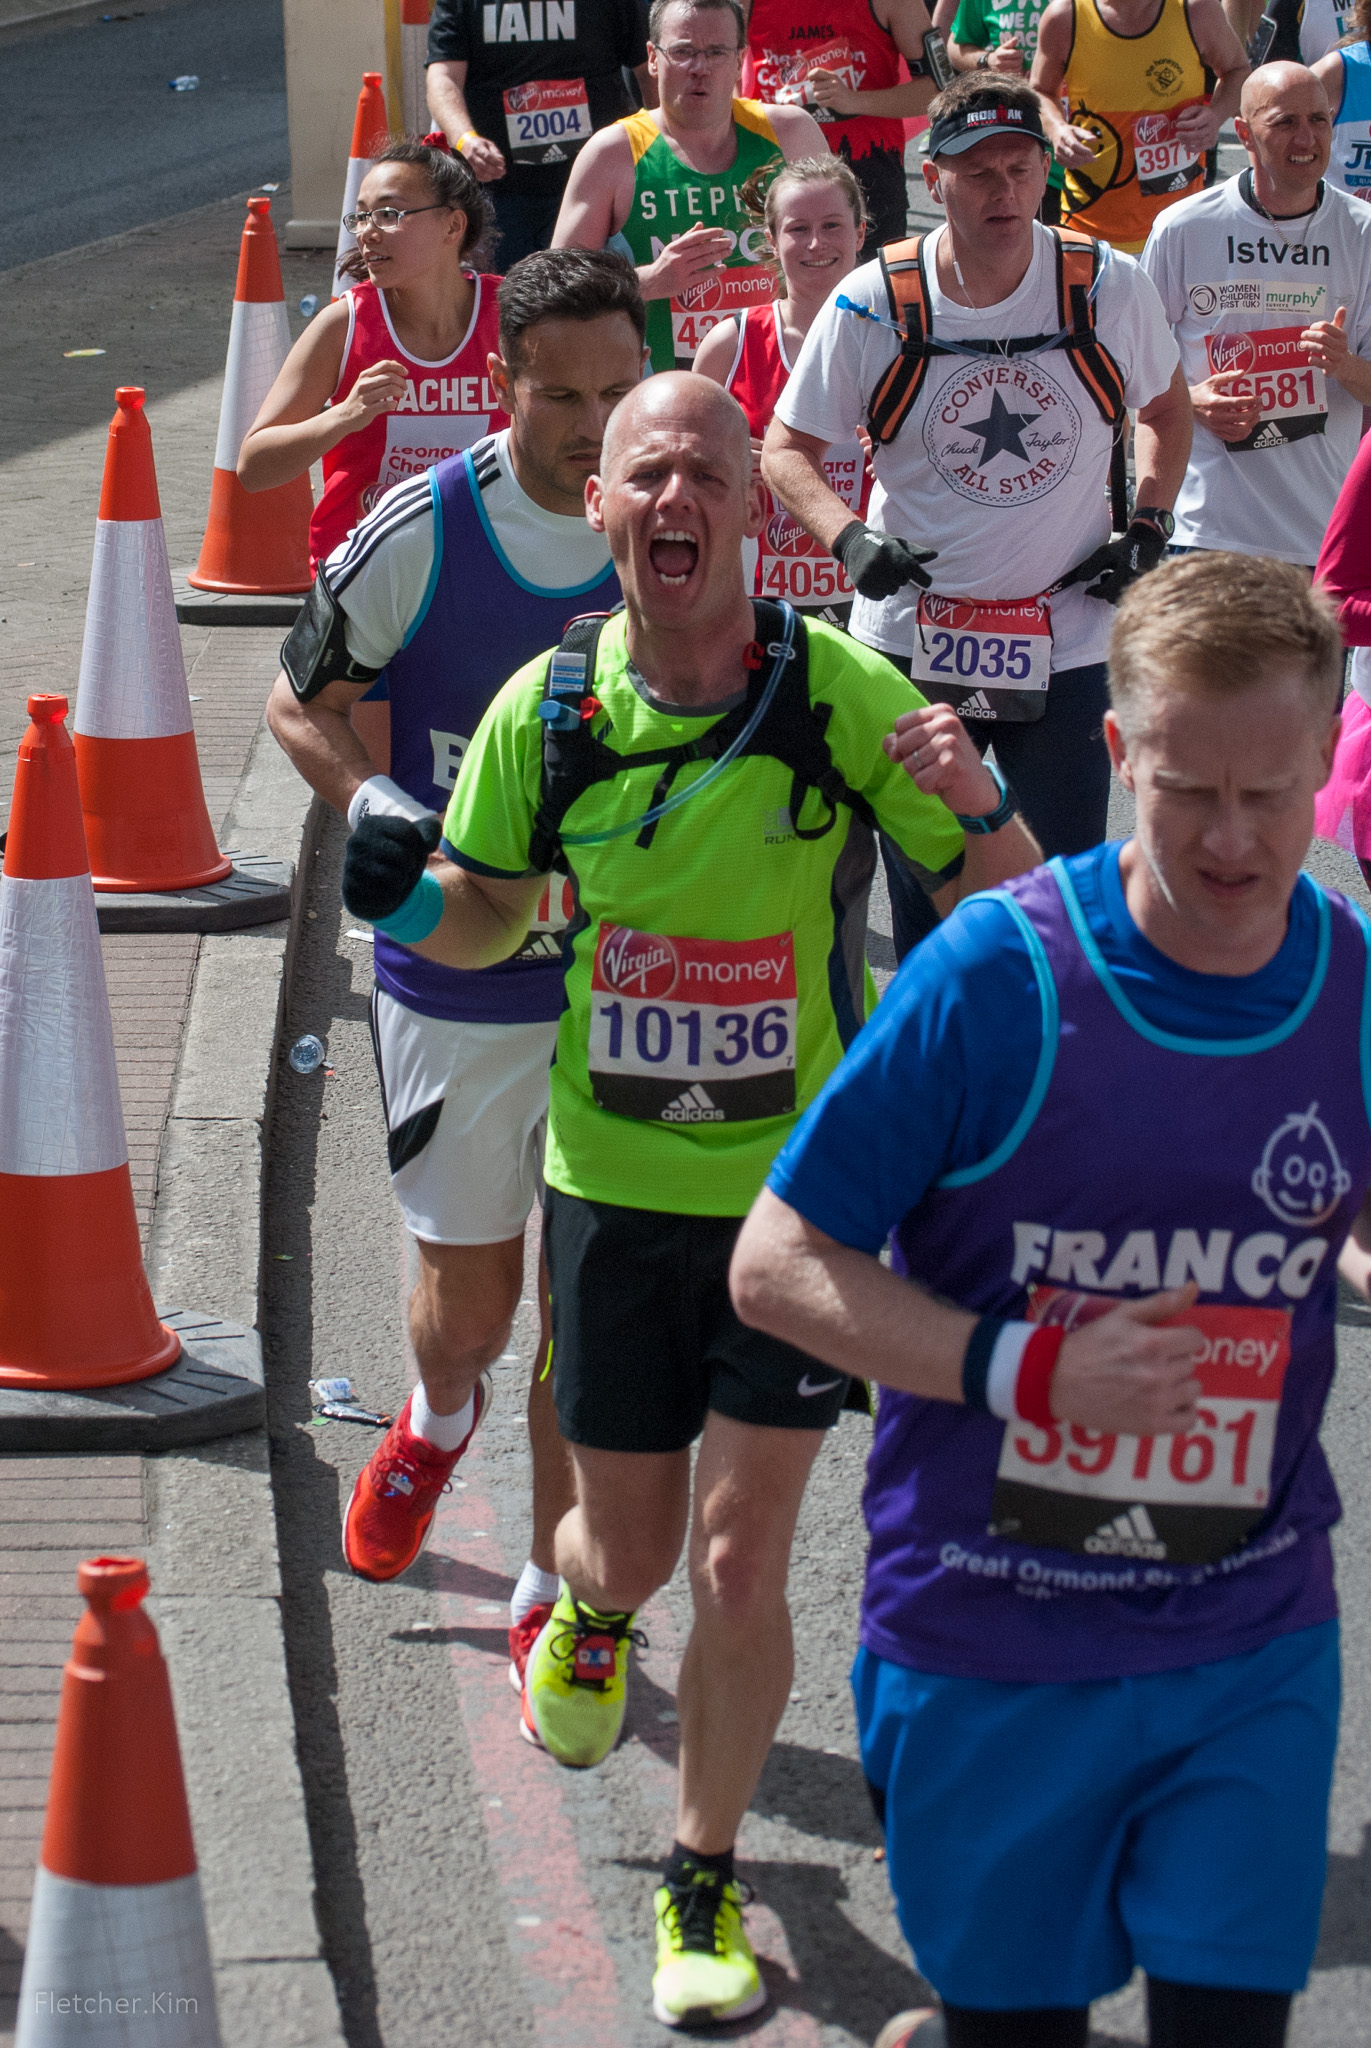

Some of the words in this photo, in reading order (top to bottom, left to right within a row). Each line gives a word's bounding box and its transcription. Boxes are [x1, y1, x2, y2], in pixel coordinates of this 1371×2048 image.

[483, 1, 576, 43] IAIN
[789, 25, 835, 40] JAMES
[999, 12, 1025, 29] WE
[809, 46, 849, 67] money
[542, 86, 582, 100] money
[517, 108, 581, 141] 2004
[1138, 115, 1168, 143] Virgin
[1227, 236, 1330, 267] Istvan
[678, 277, 718, 309] Virgin
[725, 276, 775, 294] money
[1219, 284, 1257, 295] WOMEN
[1219, 292, 1261, 303] CHILDREN
[1266, 291, 1318, 308] murphy
[1242, 301, 1261, 309] (UK)
[1212, 334, 1251, 371] Virgin
[380, 376, 499, 412] ACHEL
[941, 367, 1058, 424] CONVERSE
[941, 439, 981, 458] Chuck
[1025, 431, 1070, 452] Taylor
[1253, 436, 1289, 449] adidas
[953, 463, 989, 493] ALL
[1000, 457, 1057, 495] STAR
[929, 631, 1032, 680] 2035
[1040, 682, 1047, 690] 8
[956, 706, 998, 720] adidas
[605, 928, 672, 994] Virgin
[684, 956, 788, 985] money
[600, 1000, 789, 1067] 10136
[785, 1056, 794, 1067] 7
[660, 1108, 726, 1122] adidas
[1010, 1220, 1330, 1300] FRANCO
[1193, 1336, 1280, 1377] oney
[1083, 1534, 1168, 1561] adidas
[938, 1540, 1012, 1579] Great
[1017, 1557, 1137, 1591] Ormond
